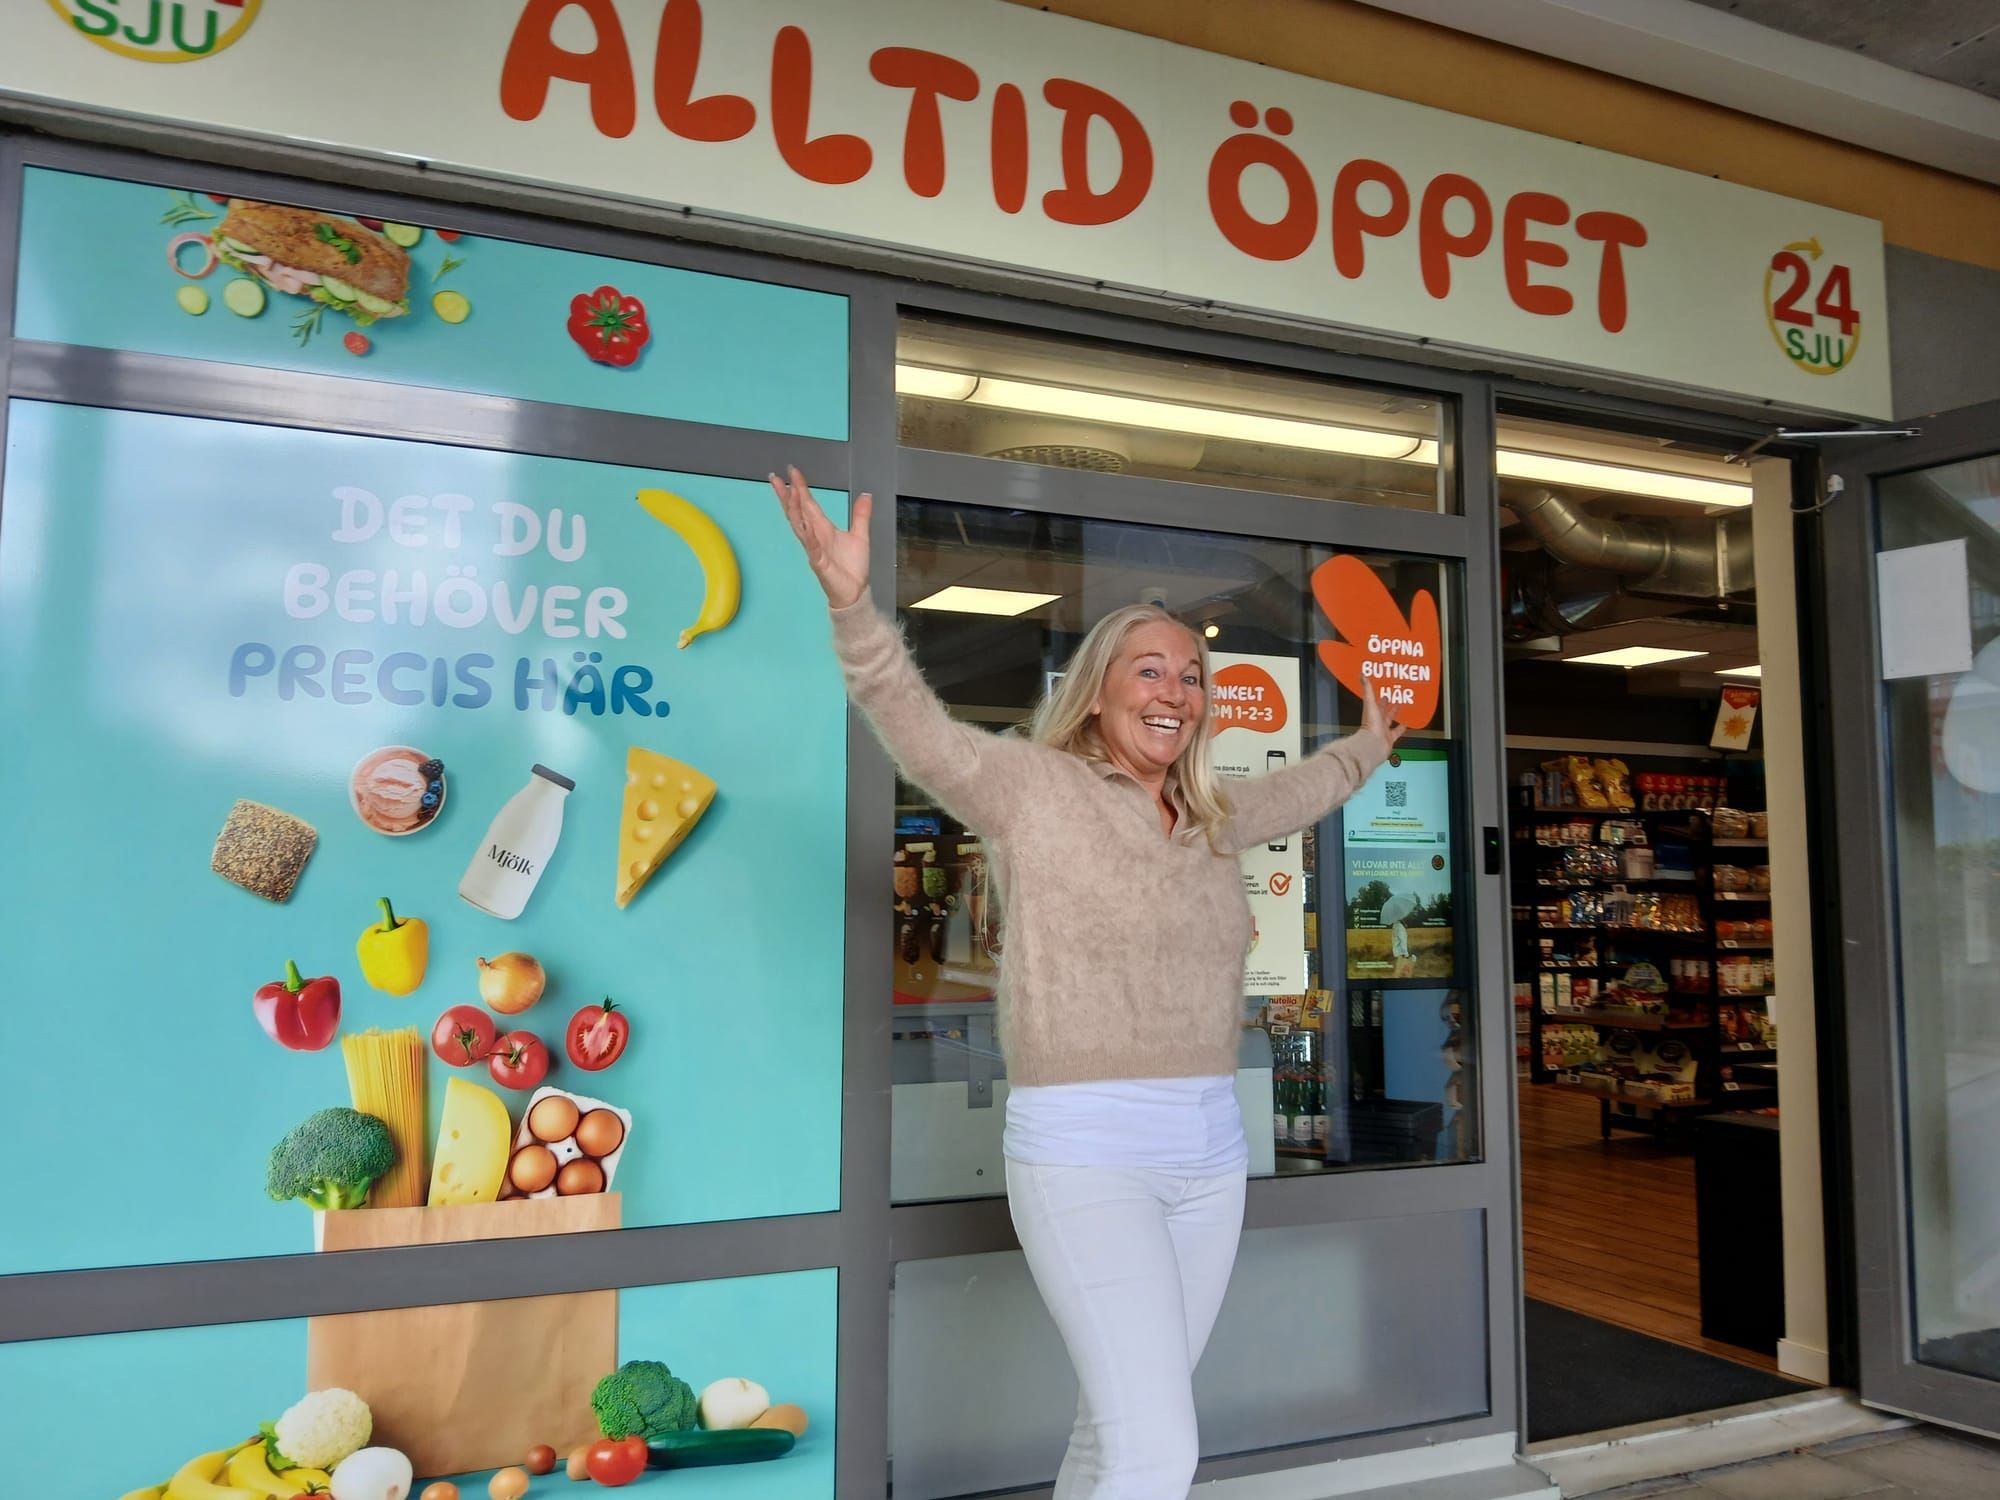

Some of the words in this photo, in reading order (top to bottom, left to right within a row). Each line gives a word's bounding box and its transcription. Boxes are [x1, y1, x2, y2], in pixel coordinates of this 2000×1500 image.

[72, 0, 218, 54] SJU
[501, 0, 1154, 225] ALLTID
[1207, 100, 1648, 334] ÖPPET
[1770, 251, 1860, 336] 24
[1786, 327, 1844, 368] SJU
[332, 486, 475, 550] DET
[492, 502, 587, 562] DU
[284, 562, 628, 639] BEHÖVER
[1367, 634, 1424, 657] ÖPPNA
[229, 642, 494, 710] PRECIS
[514, 651, 671, 718] HÄR.
[1361, 660, 1431, 681] BUTIKEN
[1380, 684, 1415, 705] HÄR
[1235, 705, 1273, 721] 1-2-3
[487, 844, 535, 876] Mjölk
[1362, 860, 1388, 869] LOVAR
[1269, 996, 1297, 1005] nutella
